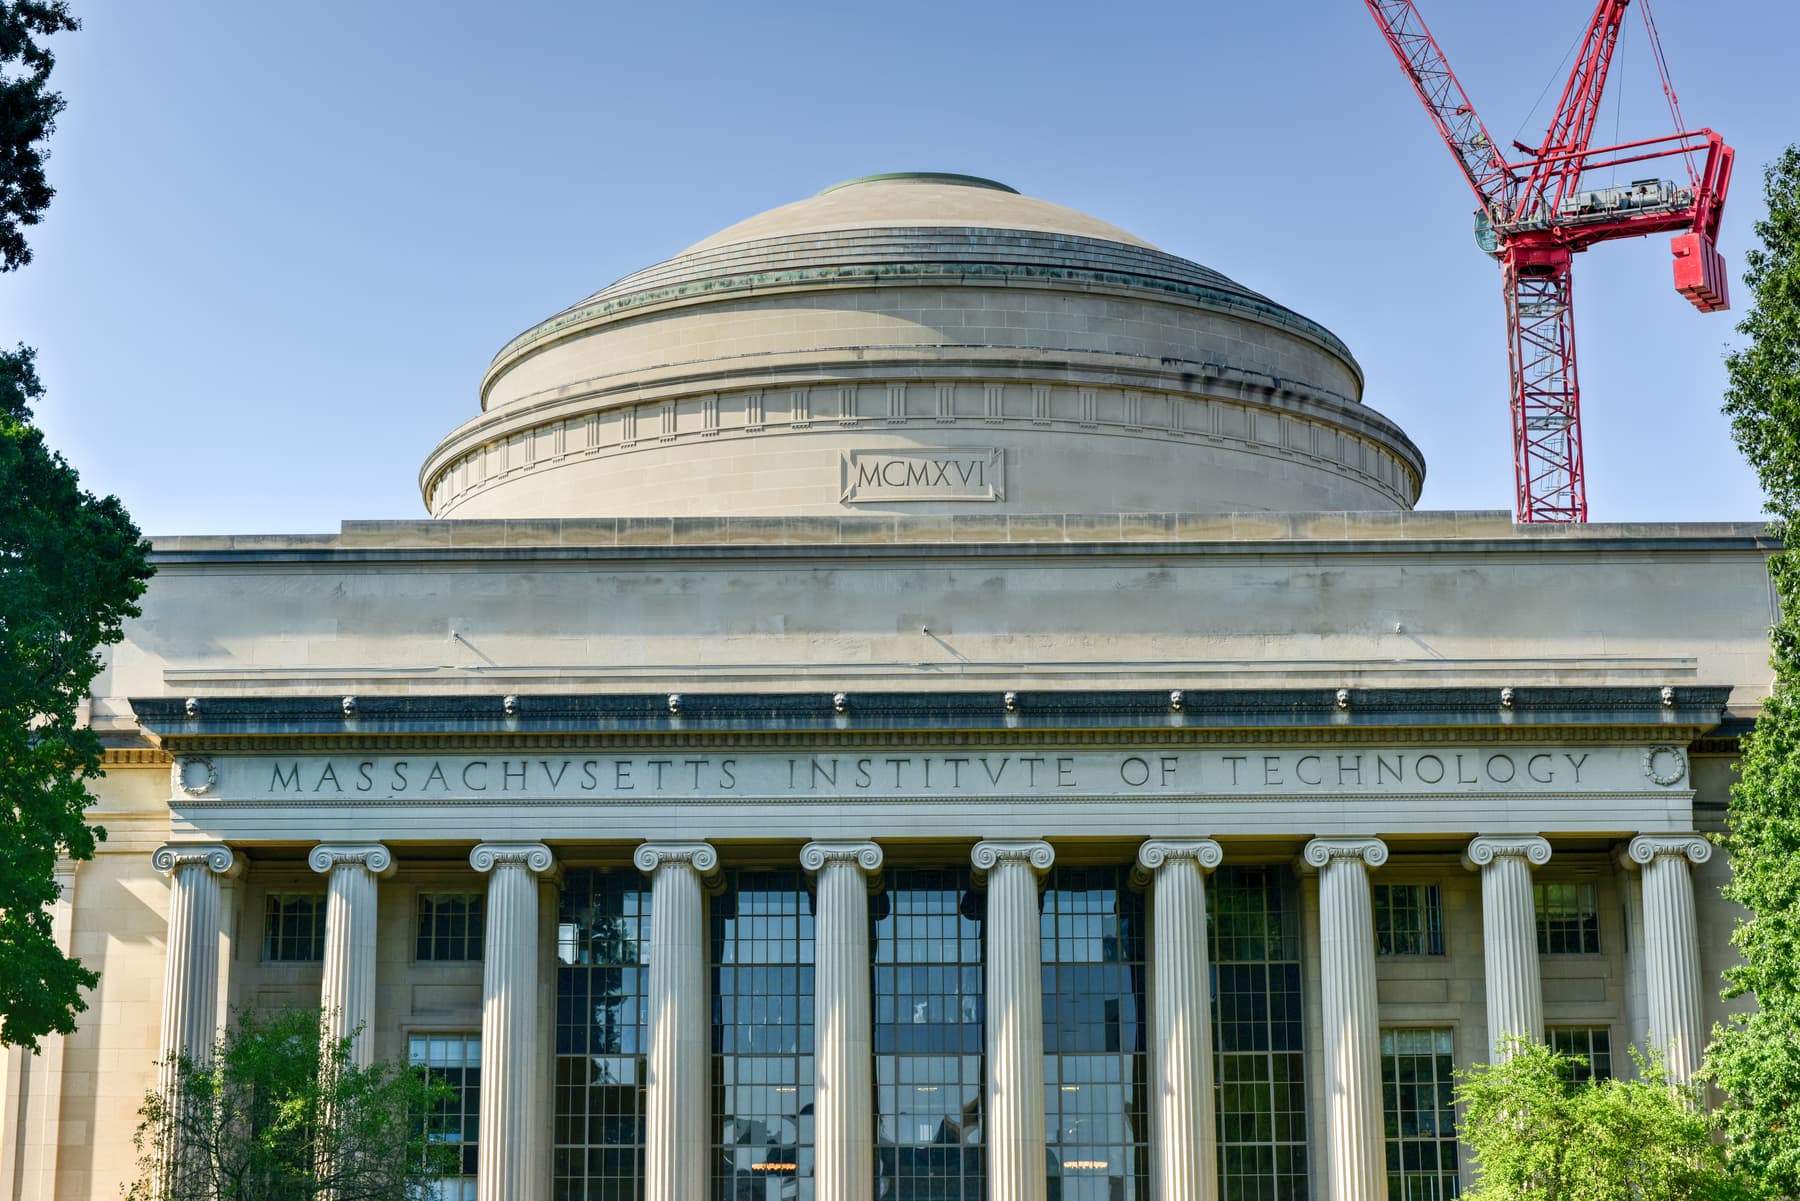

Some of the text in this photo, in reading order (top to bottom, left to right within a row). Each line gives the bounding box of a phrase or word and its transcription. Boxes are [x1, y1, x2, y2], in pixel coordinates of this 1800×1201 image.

[857, 460, 985, 488] MCMXVI
[268, 753, 1591, 793] MASSACHVSETTS INSTITVTE OF TECHNOLOGY
